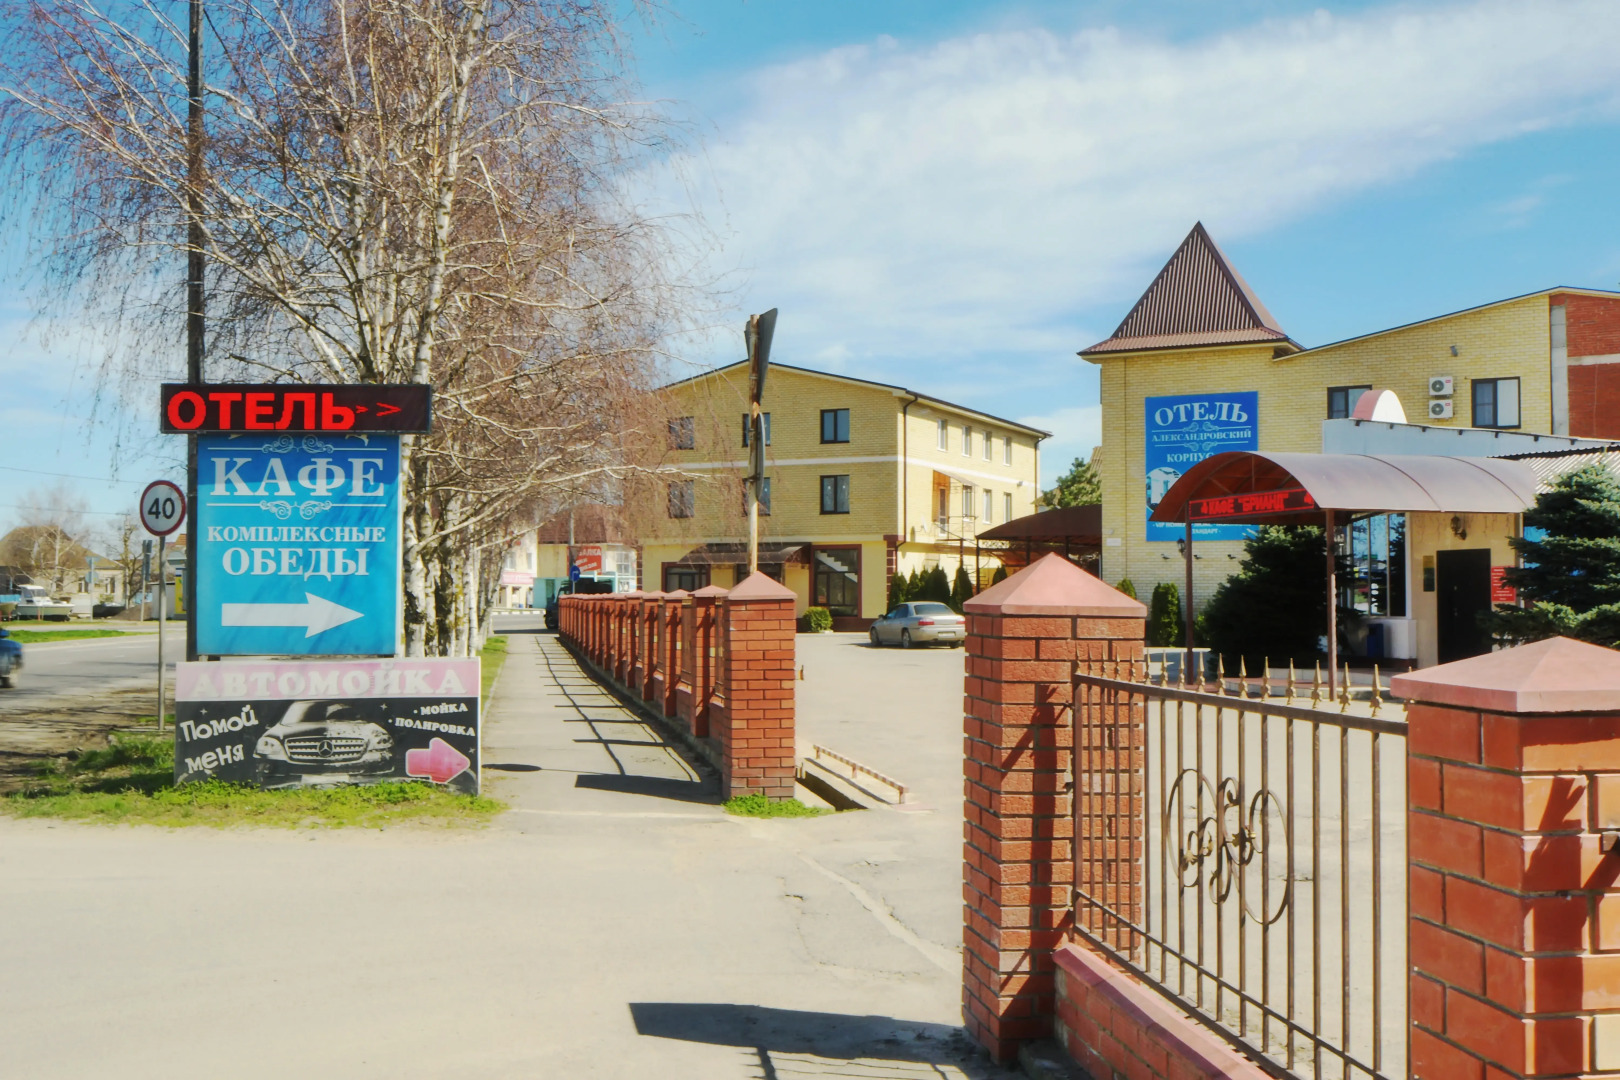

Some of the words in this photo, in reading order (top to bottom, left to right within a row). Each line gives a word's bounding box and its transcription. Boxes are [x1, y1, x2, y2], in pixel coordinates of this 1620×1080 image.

[167, 390, 356, 430] ОТЕЛЬ
[1154, 401, 1249, 427] ОТЕЛЬ
[1152, 429, 1252, 442] АЛЕКСАНДРОВСКИЙ
[209, 457, 385, 497] КАФЕ
[147, 497, 176, 519] 40
[1209, 497, 1235, 515] КАФЕ
[207, 525, 386, 543] КОМПЛЕКСНЫЕ
[222, 548, 370, 581] ОБЕДЫ
[190, 662, 468, 699] АВТОМОЙКА
[420, 702, 468, 716] МОЙКА
[179, 704, 259, 743] Помой
[394, 717, 476, 737] ПОЛИРОВКА
[184, 743, 244, 775] меня
